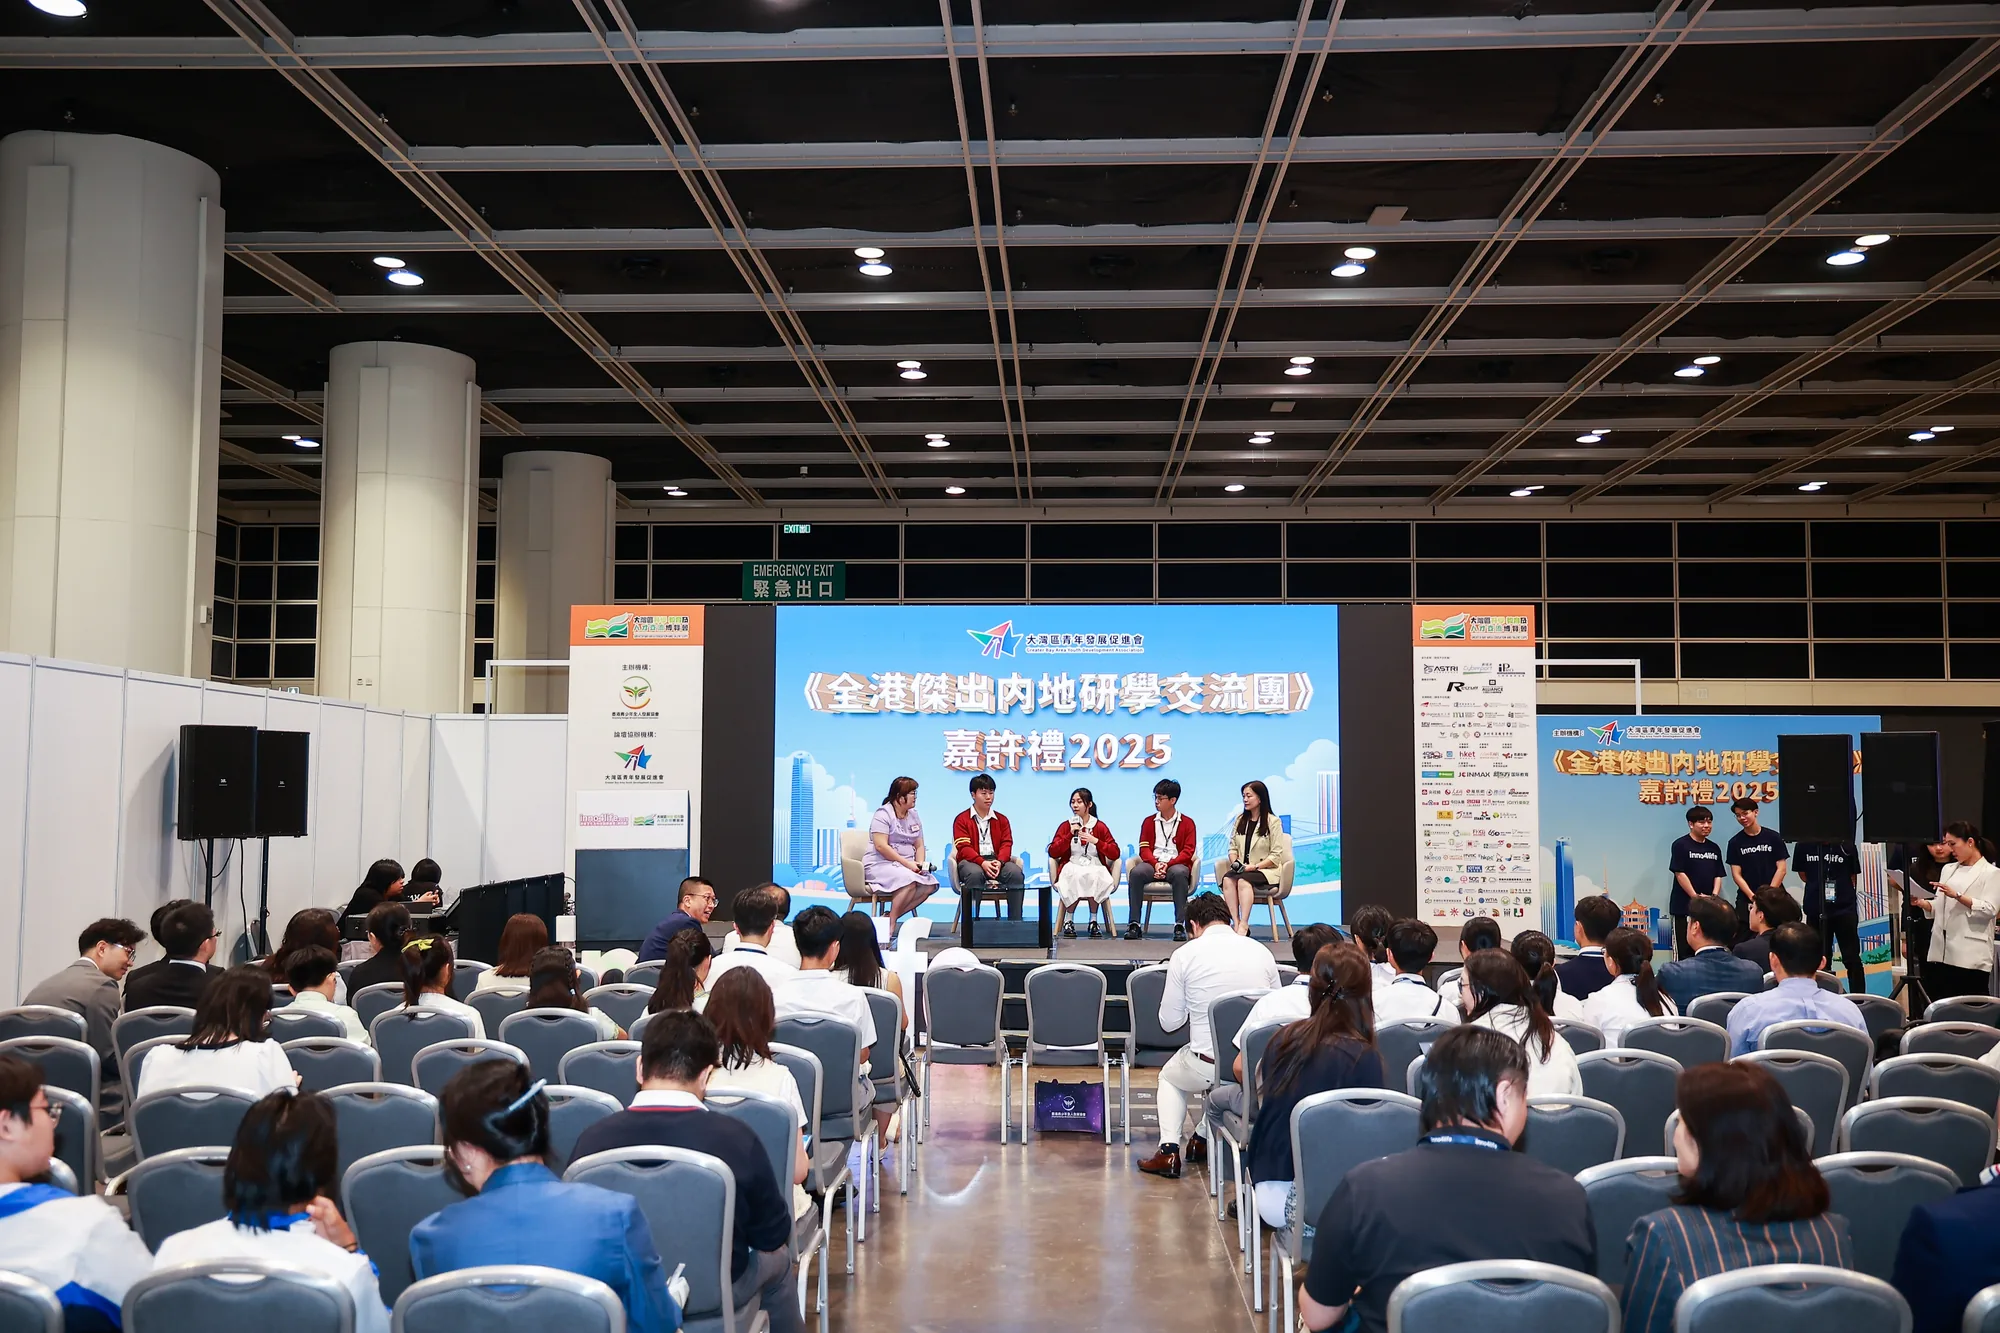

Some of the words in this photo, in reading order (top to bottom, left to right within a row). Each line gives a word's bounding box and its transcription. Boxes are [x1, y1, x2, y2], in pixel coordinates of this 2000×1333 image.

[784, 524, 800, 533] EXIT
[753, 564, 811, 577] EMERGENCY
[813, 564, 834, 577] EXIT
[753, 579, 833, 598] 緊急出口
[1026, 634, 1143, 645] 大灣區青年發展促進會
[942, 729, 1172, 771] 嘉許禮2025
[1459, 750, 1476, 758] hket
[1638, 779, 1779, 805] 嘉許禮2025
[1740, 844, 1773, 855] inno4life
[1689, 851, 1718, 861] inno4life
[1806, 853, 1844, 864] inn4life
